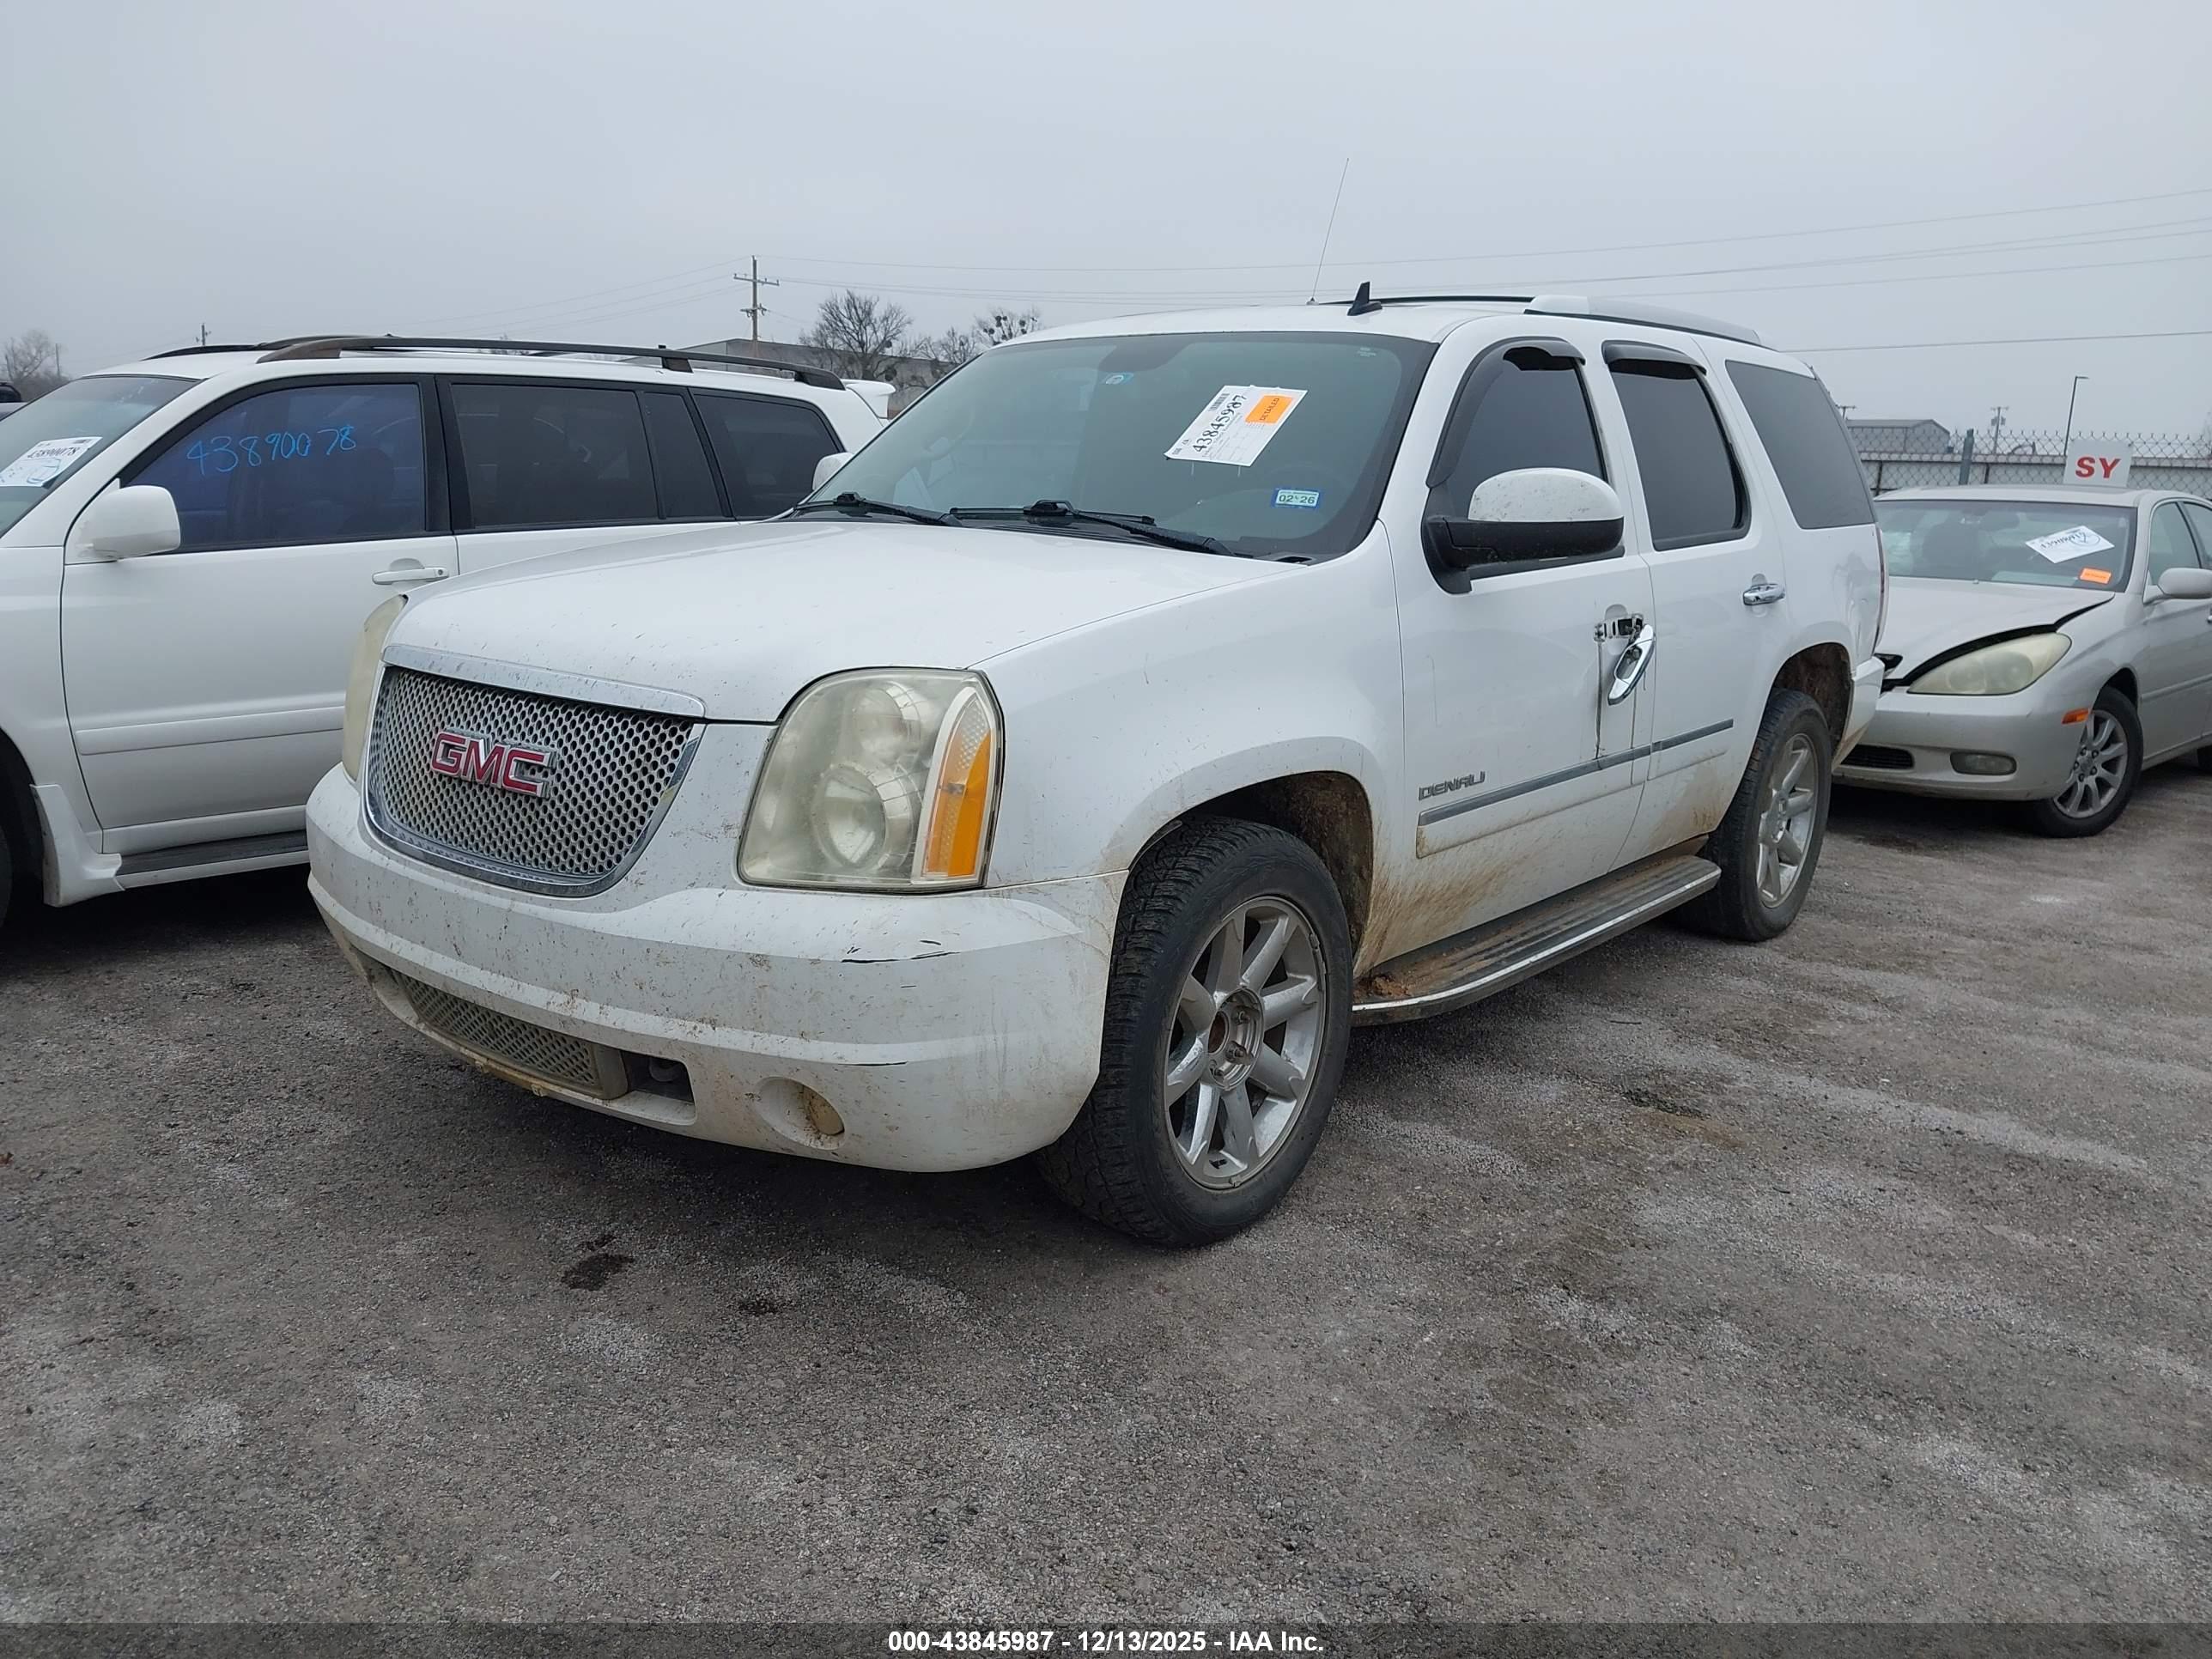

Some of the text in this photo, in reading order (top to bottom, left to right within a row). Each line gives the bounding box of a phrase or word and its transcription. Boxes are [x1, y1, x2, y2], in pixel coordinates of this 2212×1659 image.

[1192, 393, 1248, 453] 43845987
[185, 423, 357, 476] 43890078
[2075, 456, 2122, 479] SY
[1279, 494, 1316, 505] 02 26
[431, 730, 555, 799] GMC
[1418, 769, 1486, 801] DENALI
